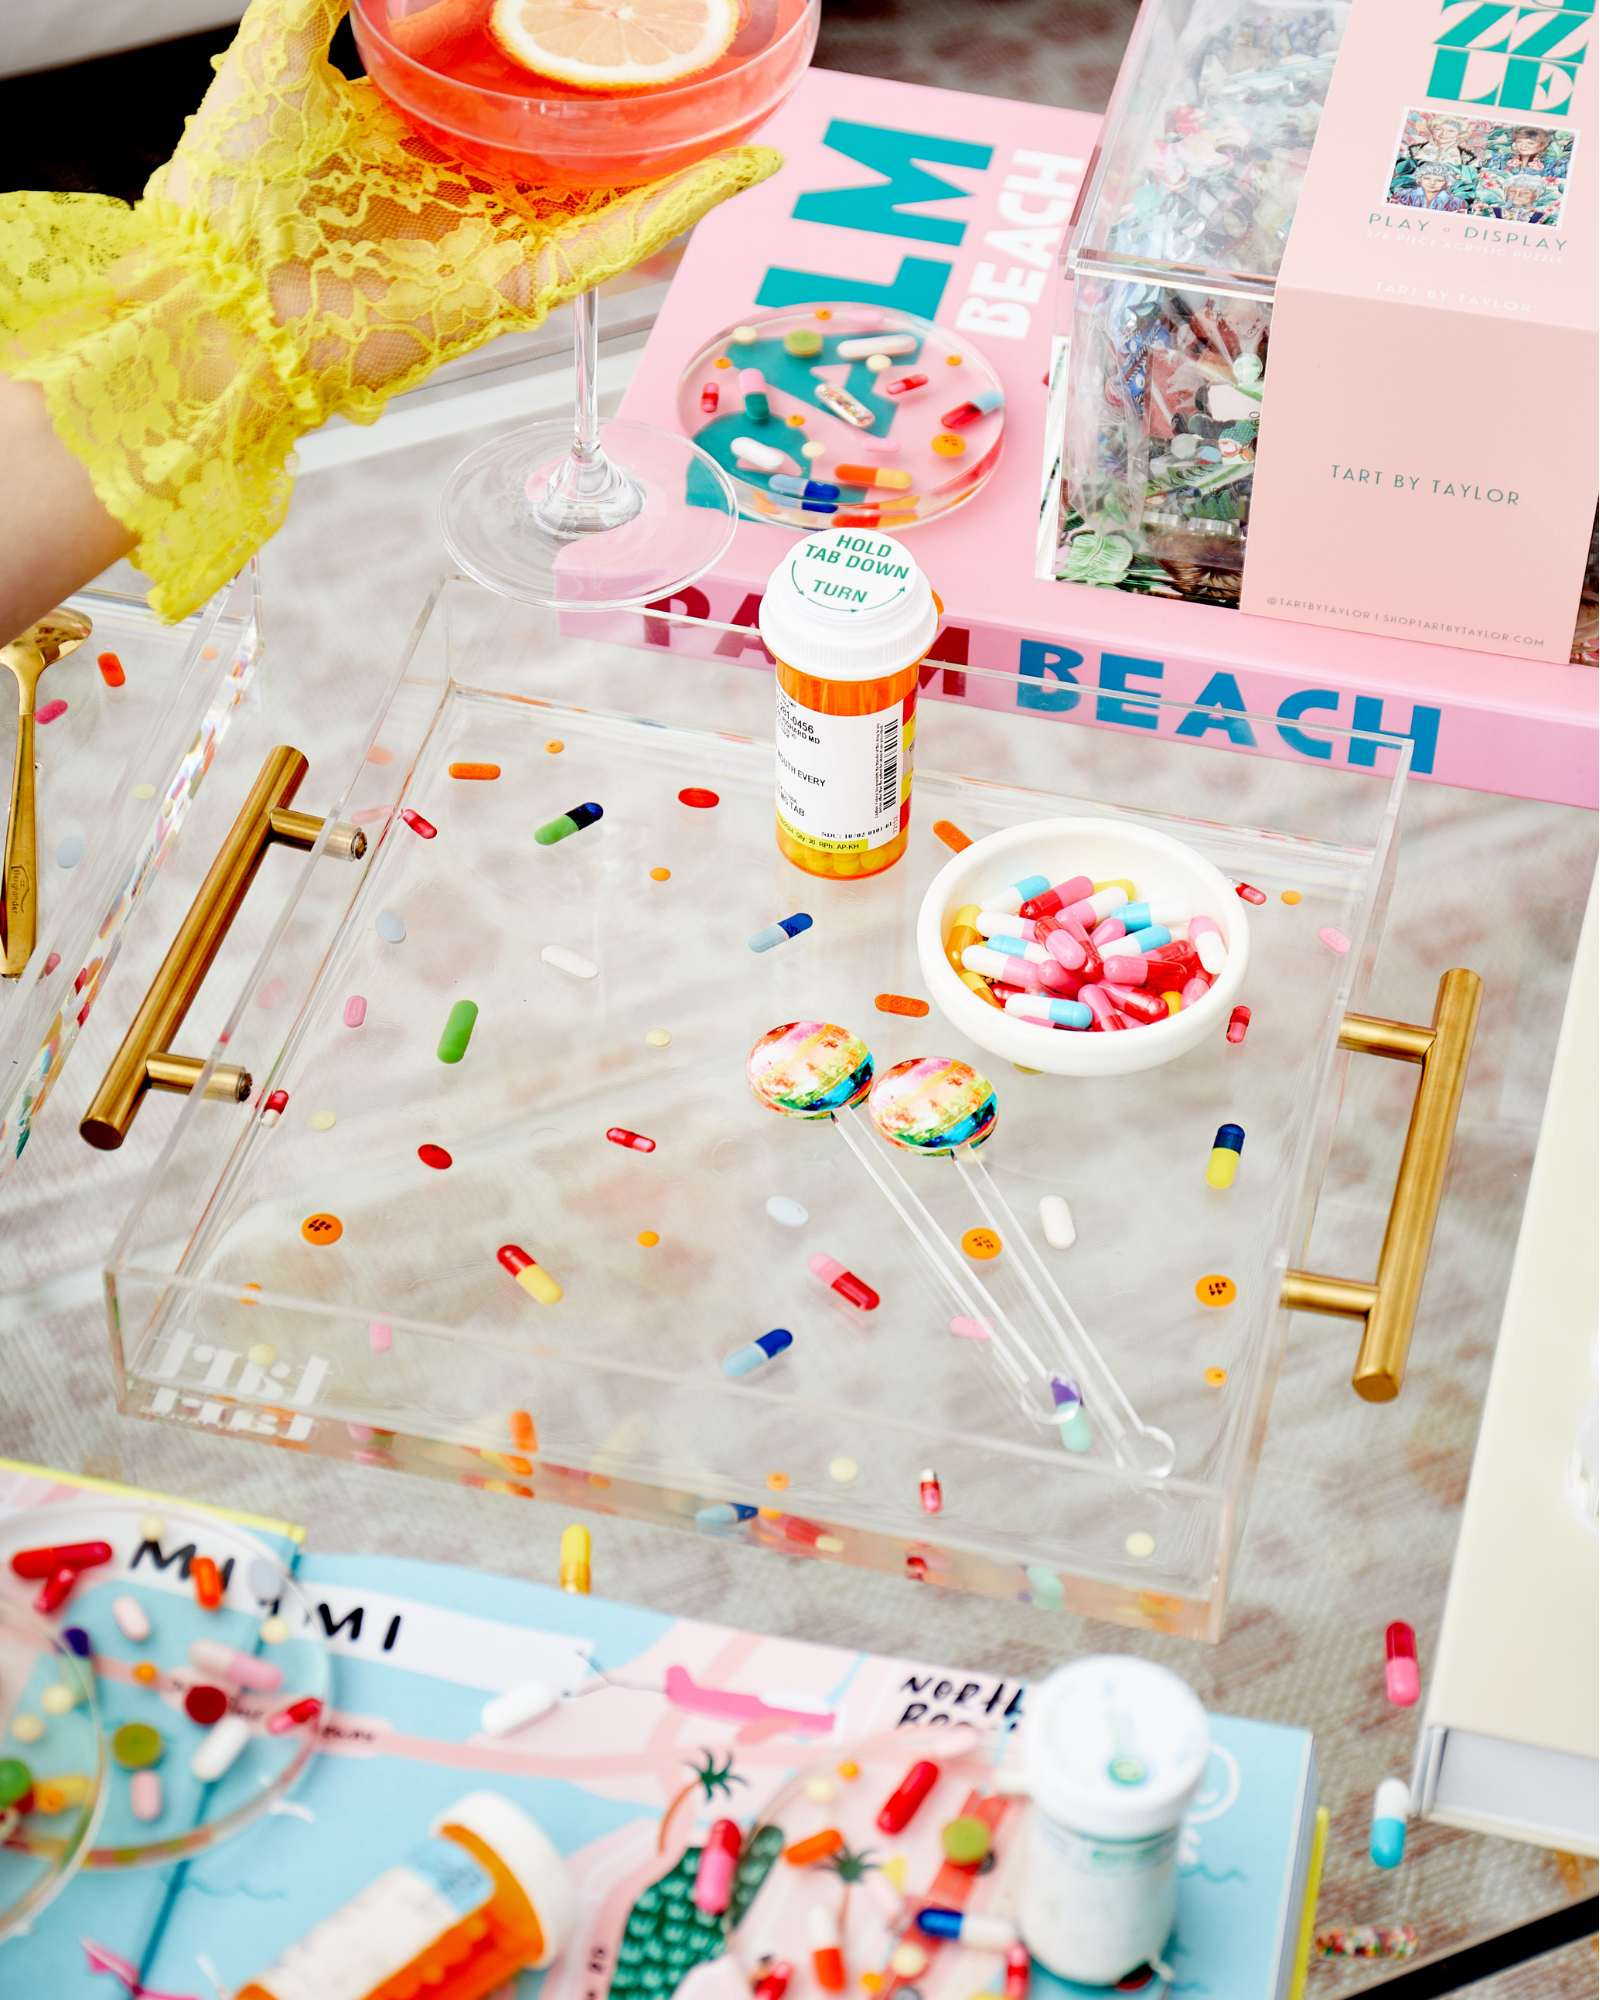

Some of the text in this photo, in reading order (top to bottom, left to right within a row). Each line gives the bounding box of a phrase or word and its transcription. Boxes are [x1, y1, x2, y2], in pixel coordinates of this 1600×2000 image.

[1426, 47, 1578, 116] LE
[955, 148, 1085, 340] BEACH
[1368, 213, 1568, 251] PLAY DISPLAY
[1513, 250, 1564, 264] PUZZLE
[1375, 281, 1532, 313] TART BY TAYLOR
[1331, 464, 1520, 506] TART BY TAYLOR
[805, 543, 909, 579] TAB DOWN
[836, 534, 892, 558] HOLD
[813, 579, 868, 603] TURN
[1267, 596, 1371, 619] @TARTBYTAYLOR
[1383, 613, 1545, 648] SHOPTARTBYTAYLOR.COM
[642, 585, 970, 698] PAM
[1016, 638, 1442, 775] BEACH
[808, 735, 821, 744] MD
[797, 769, 826, 787] EVERY
[789, 801, 805, 817] TAB
[128, 1538, 402, 1652] MIMI
